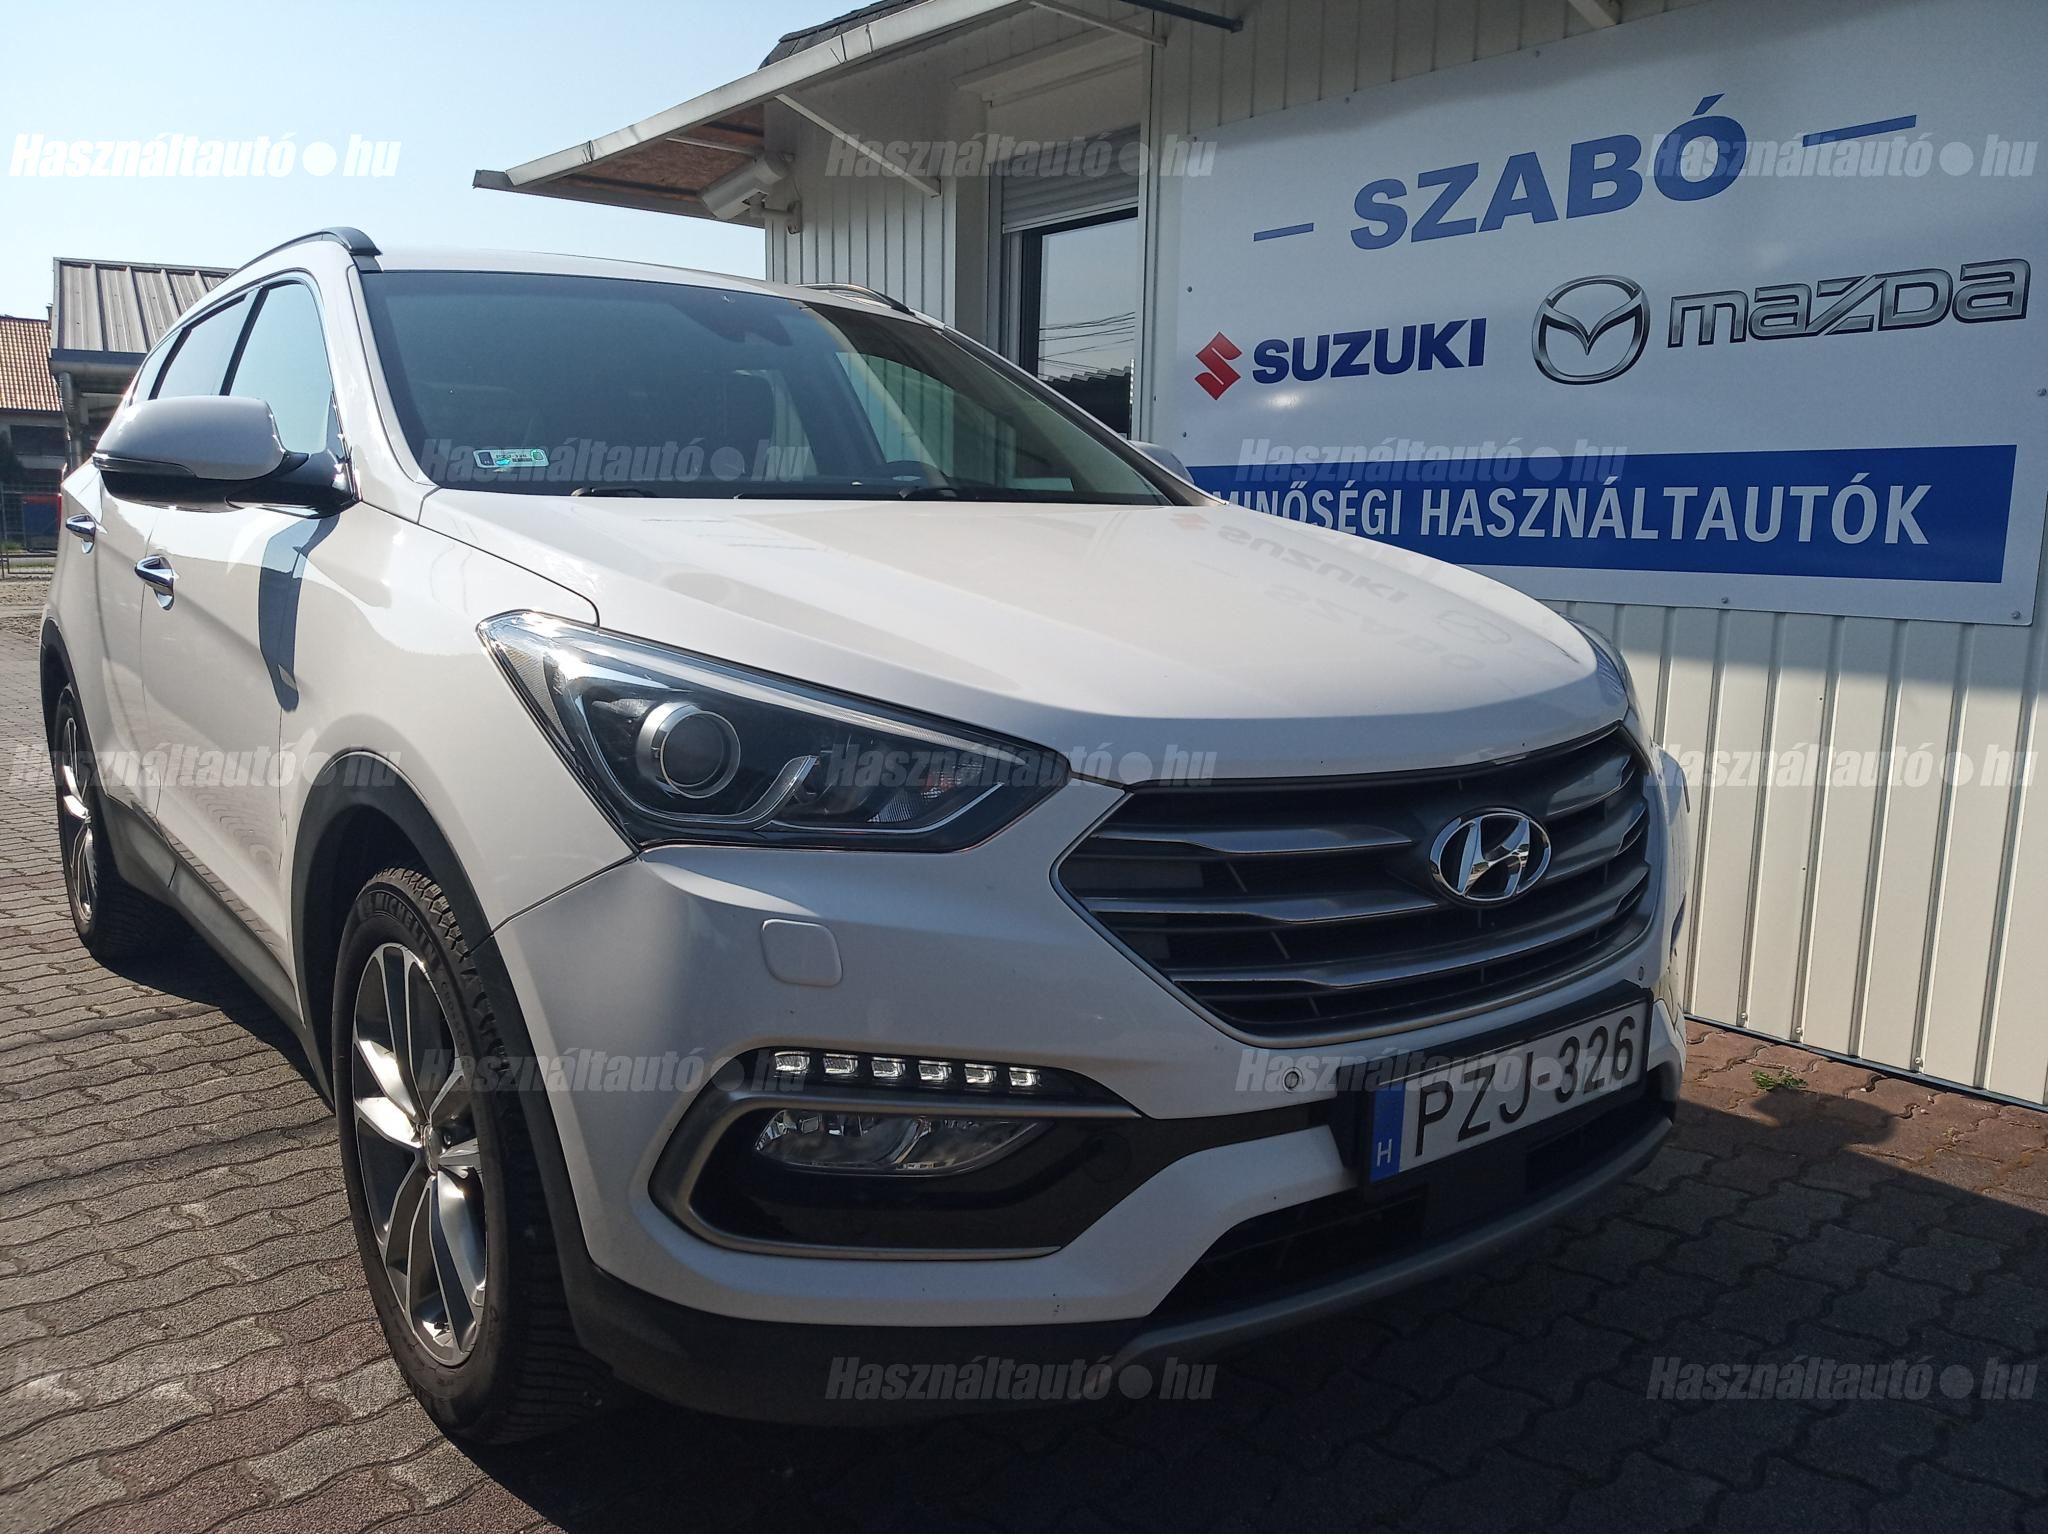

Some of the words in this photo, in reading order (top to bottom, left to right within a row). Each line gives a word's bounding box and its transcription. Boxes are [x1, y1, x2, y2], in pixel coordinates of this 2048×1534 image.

[1350, 94, 1746, 250] SZABÓ
[1252, 318, 1487, 385] SUZUKI
[1420, 473, 1932, 546] HASZNÁLTAUTÓK
[1414, 1016, 1636, 1157] PZJ-326
[1376, 1139, 1393, 1168] H
